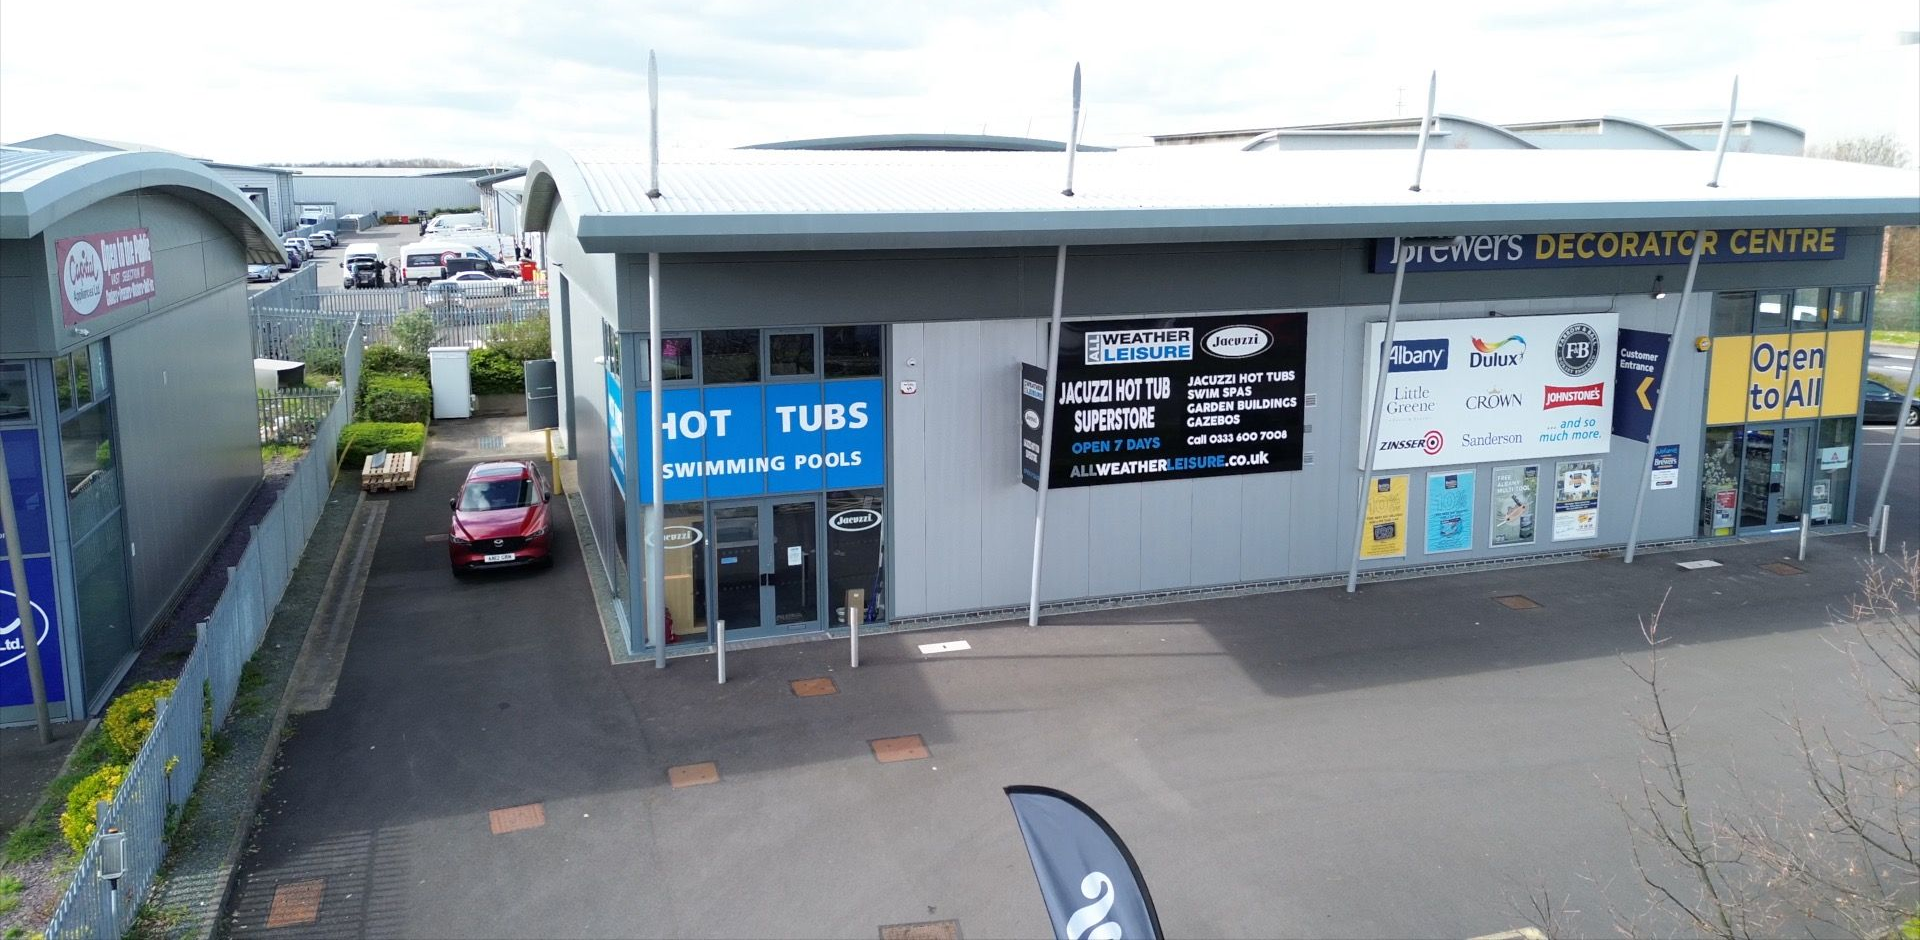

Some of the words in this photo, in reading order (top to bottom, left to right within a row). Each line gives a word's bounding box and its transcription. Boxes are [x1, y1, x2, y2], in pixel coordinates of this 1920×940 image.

[1535, 230, 1718, 260] DECORATOR
[1730, 228, 1836, 255] CENTRE
[70, 250, 98, 286] Capital
[1102, 330, 1190, 346] WEATHER
[1212, 333, 1259, 348] Jacuzzi
[1088, 334, 1100, 362] ALL
[1104, 345, 1190, 362] LEISURE
[1620, 348, 1659, 362] Customer
[1389, 345, 1443, 368] Albany
[1470, 352, 1518, 368] Dulux
[1753, 342, 1824, 380] Open
[1619, 359, 1654, 373] Entrance
[1187, 374, 1236, 387] JACUZZI
[1239, 372, 1263, 384] HOT
[1266, 370, 1295, 382] TUBS
[1059, 379, 1112, 405] JACUZZI
[1116, 378, 1143, 401] HOT
[1145, 377, 1171, 400] TUB
[1187, 387, 1219, 400] SWIM
[1222, 386, 1252, 398] SPAS
[1395, 386, 1430, 400] Little
[1546, 386, 1600, 406] JOHNSTONE'S
[1750, 383, 1779, 410] to
[1785, 377, 1821, 408] All
[1187, 401, 1234, 414] GARDEN
[1237, 397, 1297, 411] BUILDINGS
[1387, 401, 1435, 415] Greene
[1466, 394, 1522, 410] CROWN
[775, 401, 868, 433] TUBS
[1074, 406, 1155, 433] SUPERSTORE
[1187, 414, 1240, 427] GAZEBOS
[1560, 416, 1581, 429] and
[1584, 418, 1596, 428] so
[1187, 434, 1207, 445] Call
[1209, 433, 1234, 444] 0333
[1236, 432, 1258, 442] 600
[1260, 430, 1287, 441] 7008
[1462, 432, 1522, 448] Sanderson
[1540, 430, 1568, 442] much
[1572, 430, 1602, 441] more.
[1072, 440, 1110, 454] OPEN
[1114, 439, 1123, 452] 7
[1126, 437, 1161, 451] DAYS
[1379, 439, 1425, 451] ZINSSER
[662, 456, 785, 479] SWIMMING
[795, 451, 862, 470] POOLS
[1070, 451, 1269, 478] ALLWEATHERLEISURE.co.uk
[836, 513, 873, 526] Jacuzzi
